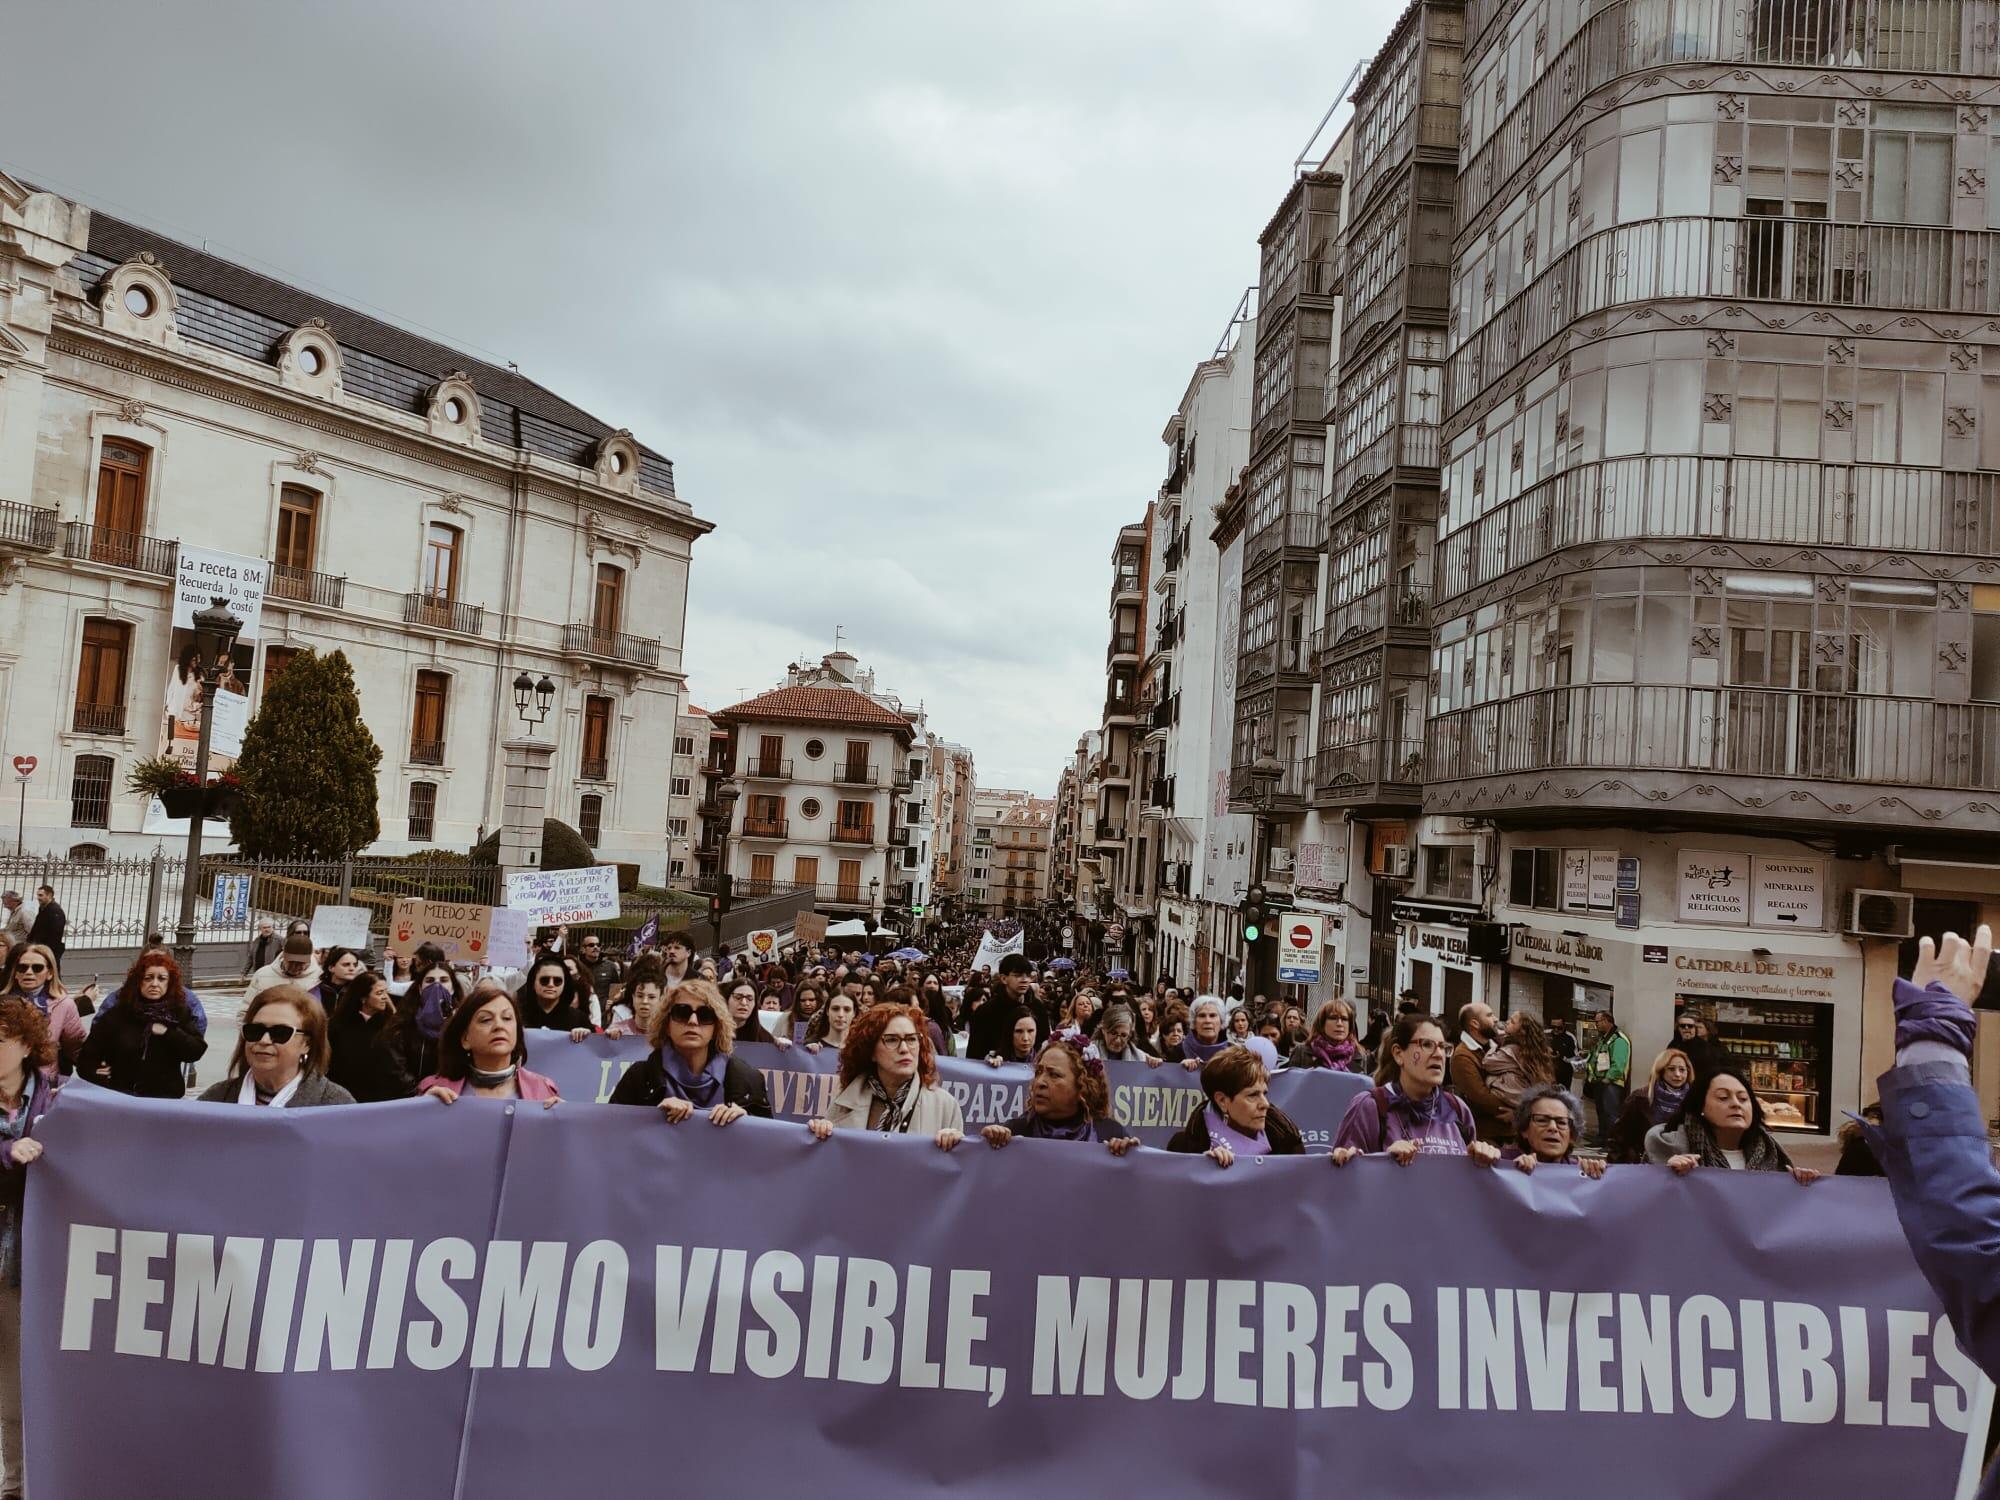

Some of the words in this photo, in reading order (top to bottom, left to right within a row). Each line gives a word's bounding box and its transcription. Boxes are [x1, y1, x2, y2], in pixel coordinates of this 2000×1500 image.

[180, 556, 194, 570] La
[200, 562, 237, 579] receta
[242, 568, 264, 584] 8M:
[179, 574, 223, 593] Recuerda
[229, 583, 238, 596] lo
[244, 589, 260, 601] que
[181, 592, 206, 605] tanto
[231, 602, 254, 614] costó
[1765, 864, 1814, 874] SOUVENIRS
[538, 890, 557, 902] NO
[1764, 882, 1815, 892] MINERALES
[1687, 902, 1741, 913] RELIGIOSOS
[1690, 892, 1740, 904] ARTÍCULOS
[1768, 900, 1808, 910] REGALOS
[399, 902, 415, 915] MI
[424, 904, 466, 920] MIEDO
[467, 908, 484, 920] SE
[1422, 932, 1446, 950] SABOR
[1447, 938, 1468, 954] KEBA
[1516, 932, 1552, 952] CATEDRAL
[1575, 940, 1604, 961] SABOR
[1675, 956, 1752, 974] CATEDRAL
[1787, 962, 1835, 978] SABOR
[1114, 1084, 1208, 1128] SIEMP
[1298, 1129, 1330, 1143] tas
[60, 1223, 630, 1372] FEMINISMO
[655, 1244, 1006, 1408] VISIBLE,
[1031, 1274, 1415, 1411] MUJERES
[1437, 1286, 1984, 1434] INVENCIBLES
